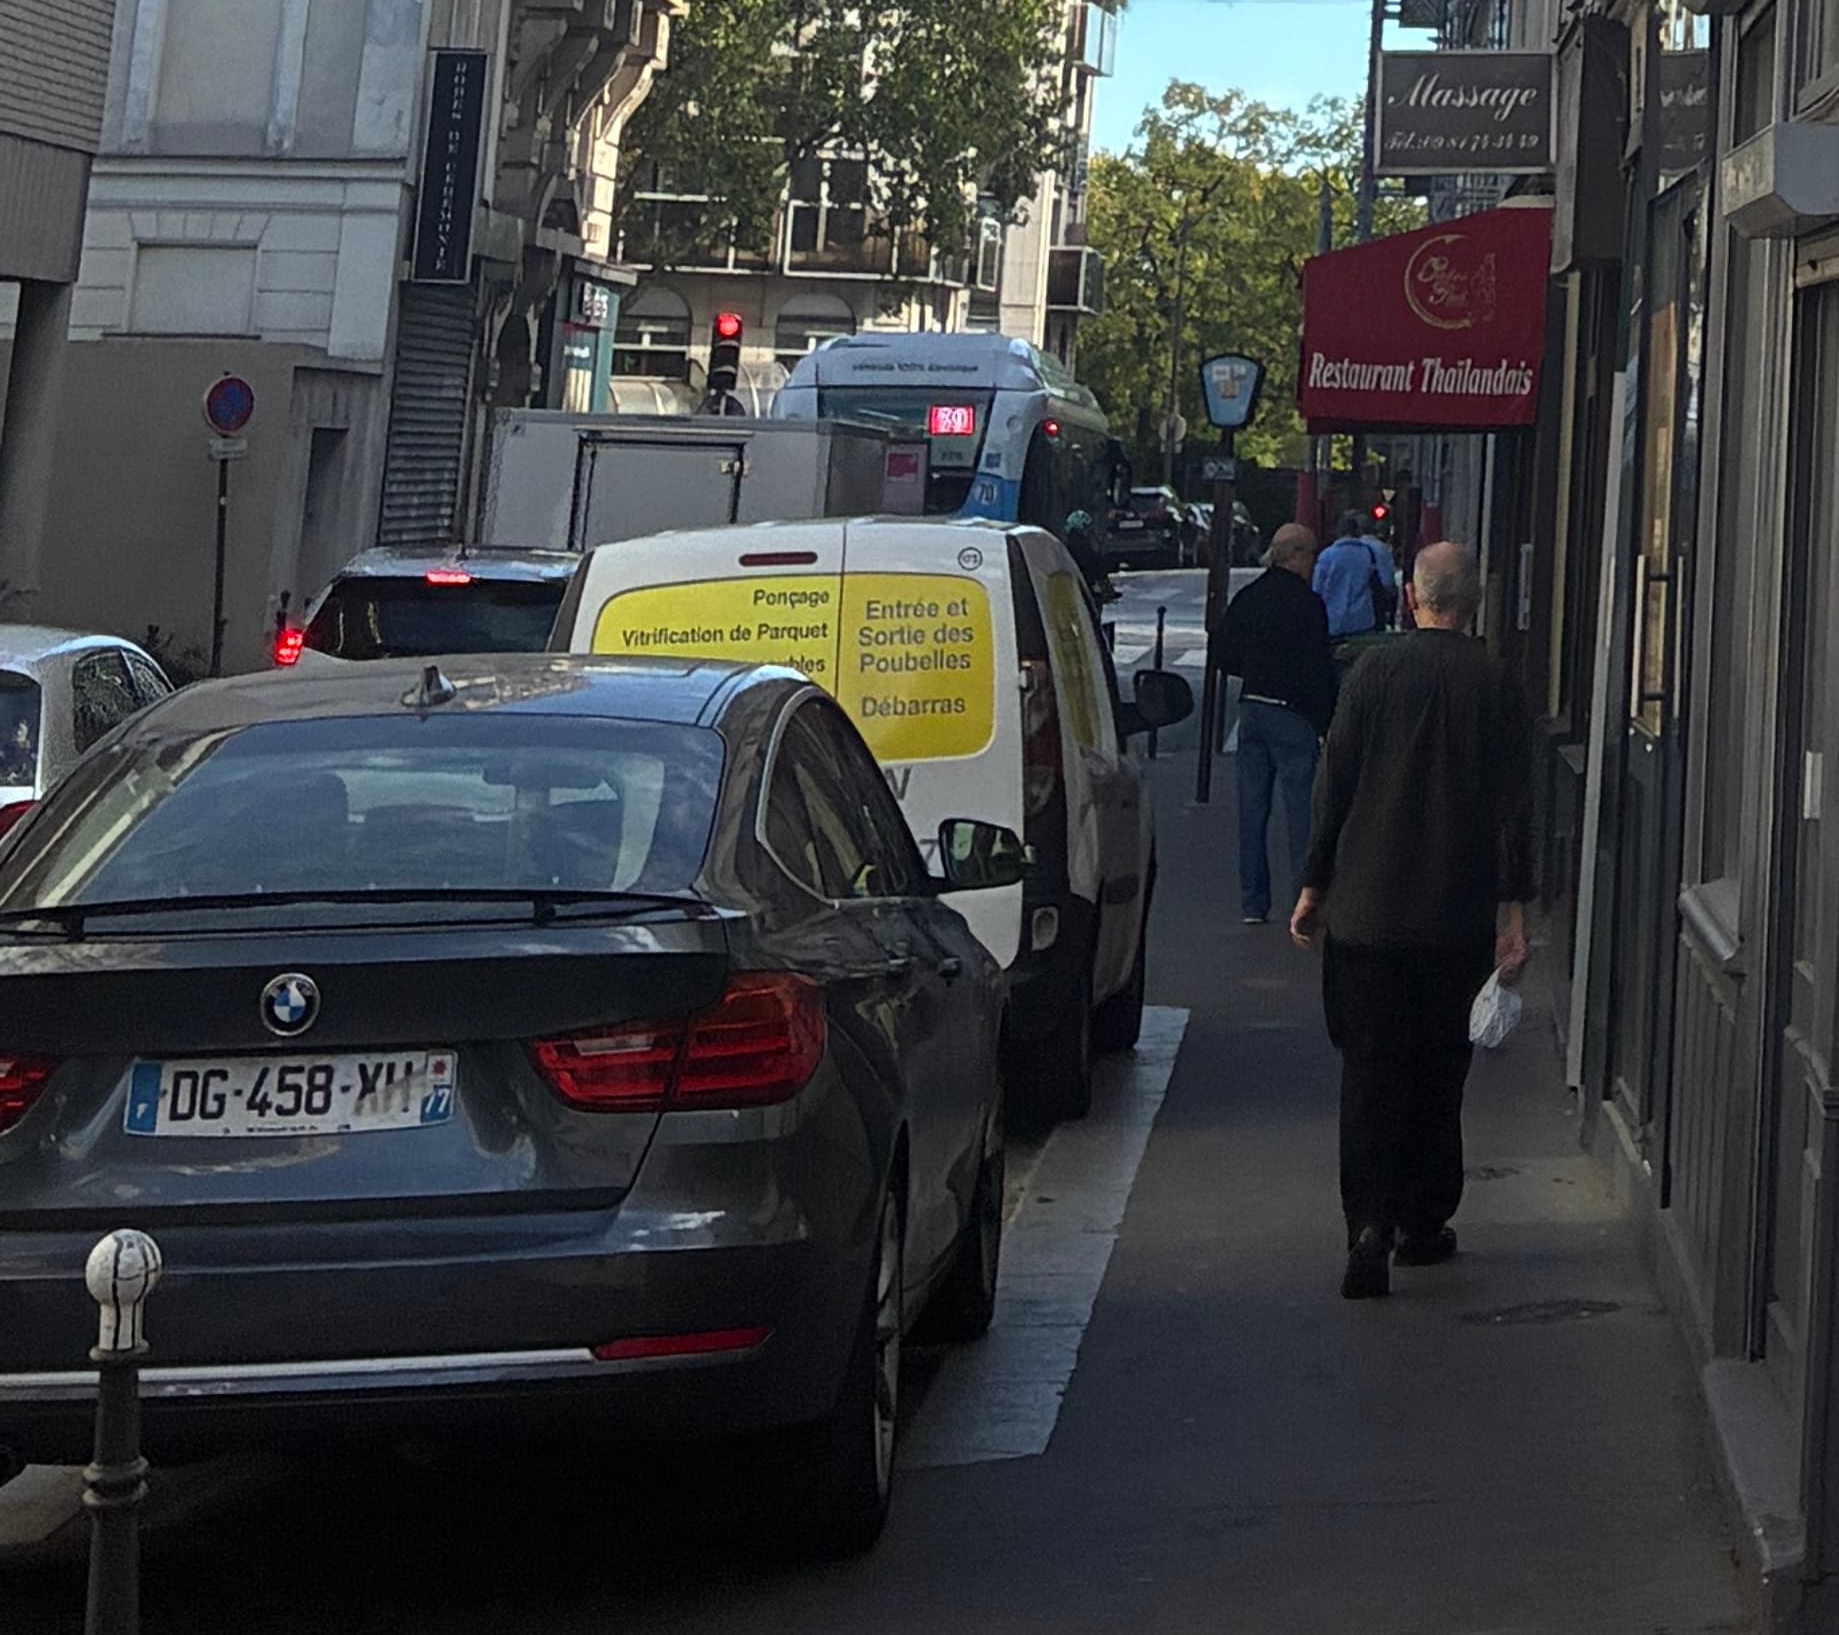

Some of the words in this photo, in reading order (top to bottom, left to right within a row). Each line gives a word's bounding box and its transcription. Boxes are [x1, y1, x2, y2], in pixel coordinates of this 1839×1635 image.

[1387, 73, 1538, 122] Massage
[1308, 351, 1415, 393] Restaurant
[753, 588, 830, 610] Ponçage
[865, 598, 941, 621] Entrée
[946, 597, 969, 618] et
[622, 624, 724, 648] Vitrification
[729, 623, 752, 642] de
[757, 622, 828, 642] Parquet
[858, 625, 926, 647] Sortie
[933, 623, 975, 644] des
[859, 649, 972, 674] Poubelles
[860, 695, 967, 718] Débarras
